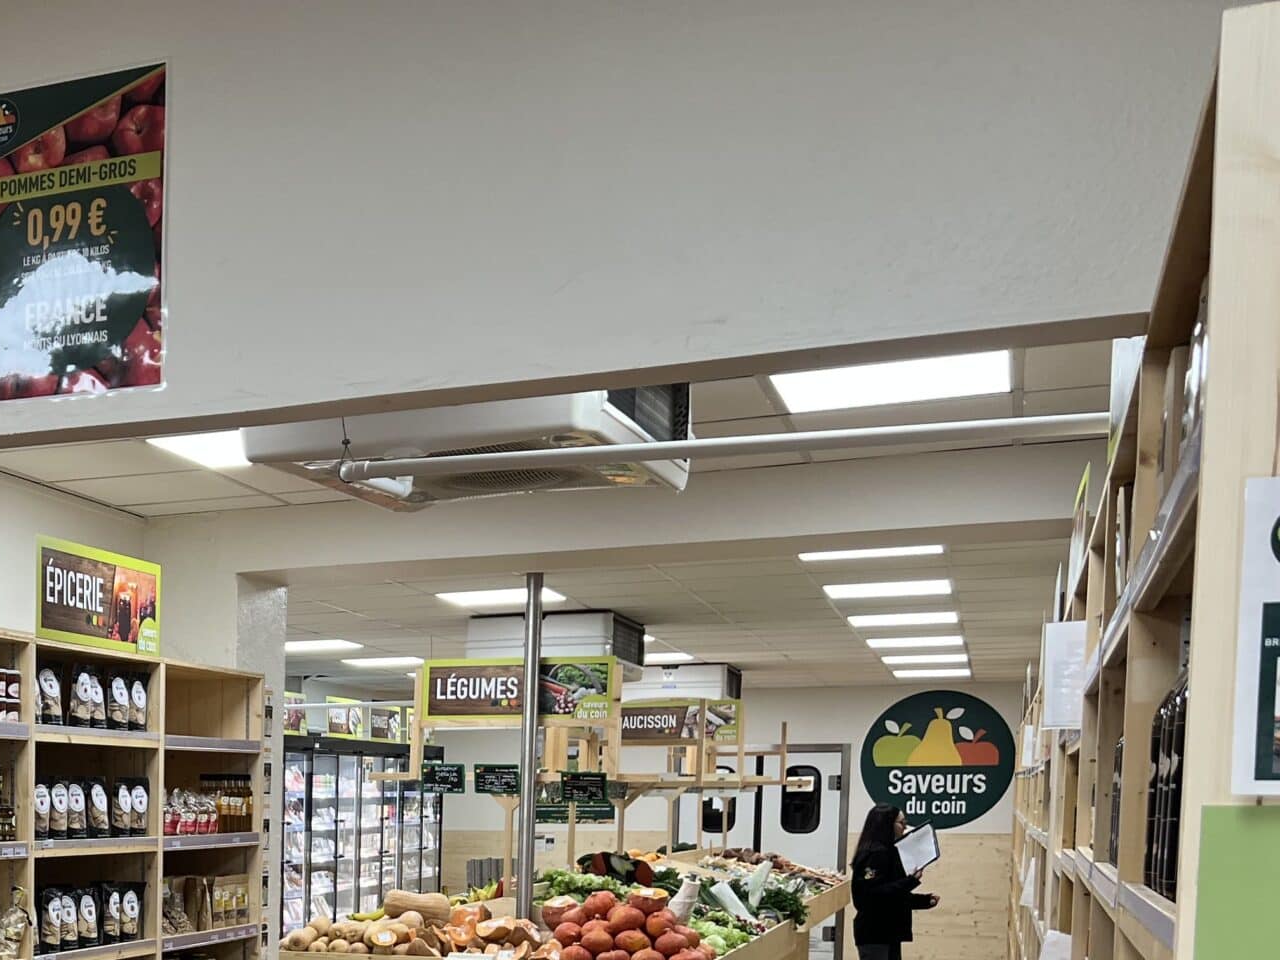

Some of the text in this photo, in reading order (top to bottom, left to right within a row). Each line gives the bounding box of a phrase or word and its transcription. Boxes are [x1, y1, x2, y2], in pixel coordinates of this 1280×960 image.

[0, 159, 136, 198] POMMES DEMI-GROS
[27, 197, 107, 250] 0,99 €
[46, 558, 104, 613] ÉPICERIE
[436, 674, 518, 700] LÉGUMES
[622, 715, 677, 729] AUCISSON
[888, 769, 987, 794] Saveurs
[906, 796, 966, 814] du coin
